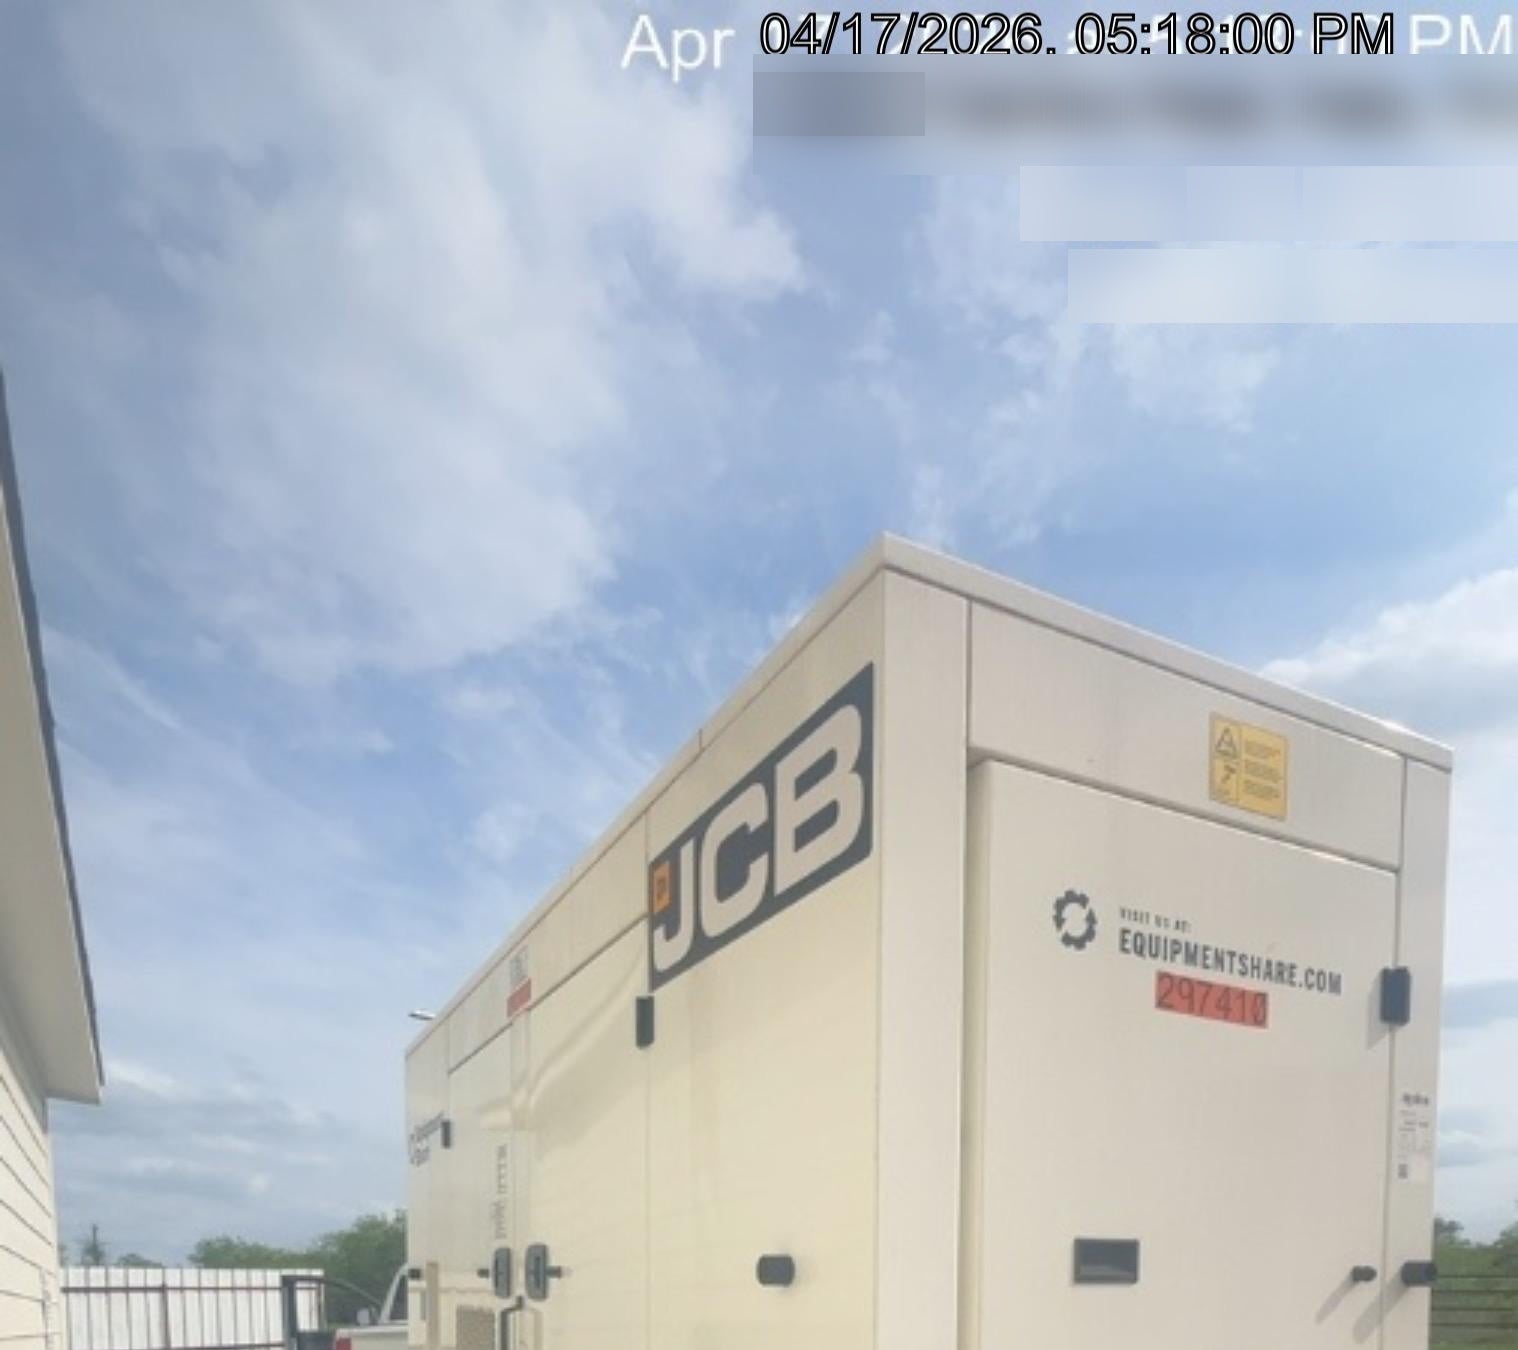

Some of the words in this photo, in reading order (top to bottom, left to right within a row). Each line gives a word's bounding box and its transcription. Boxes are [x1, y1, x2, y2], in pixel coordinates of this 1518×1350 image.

[652, 703, 865, 974] JCB
[1119, 927, 1342, 996] EQUIPMENTSHARE.COM
[1156, 972, 1268, 1027] 297410
